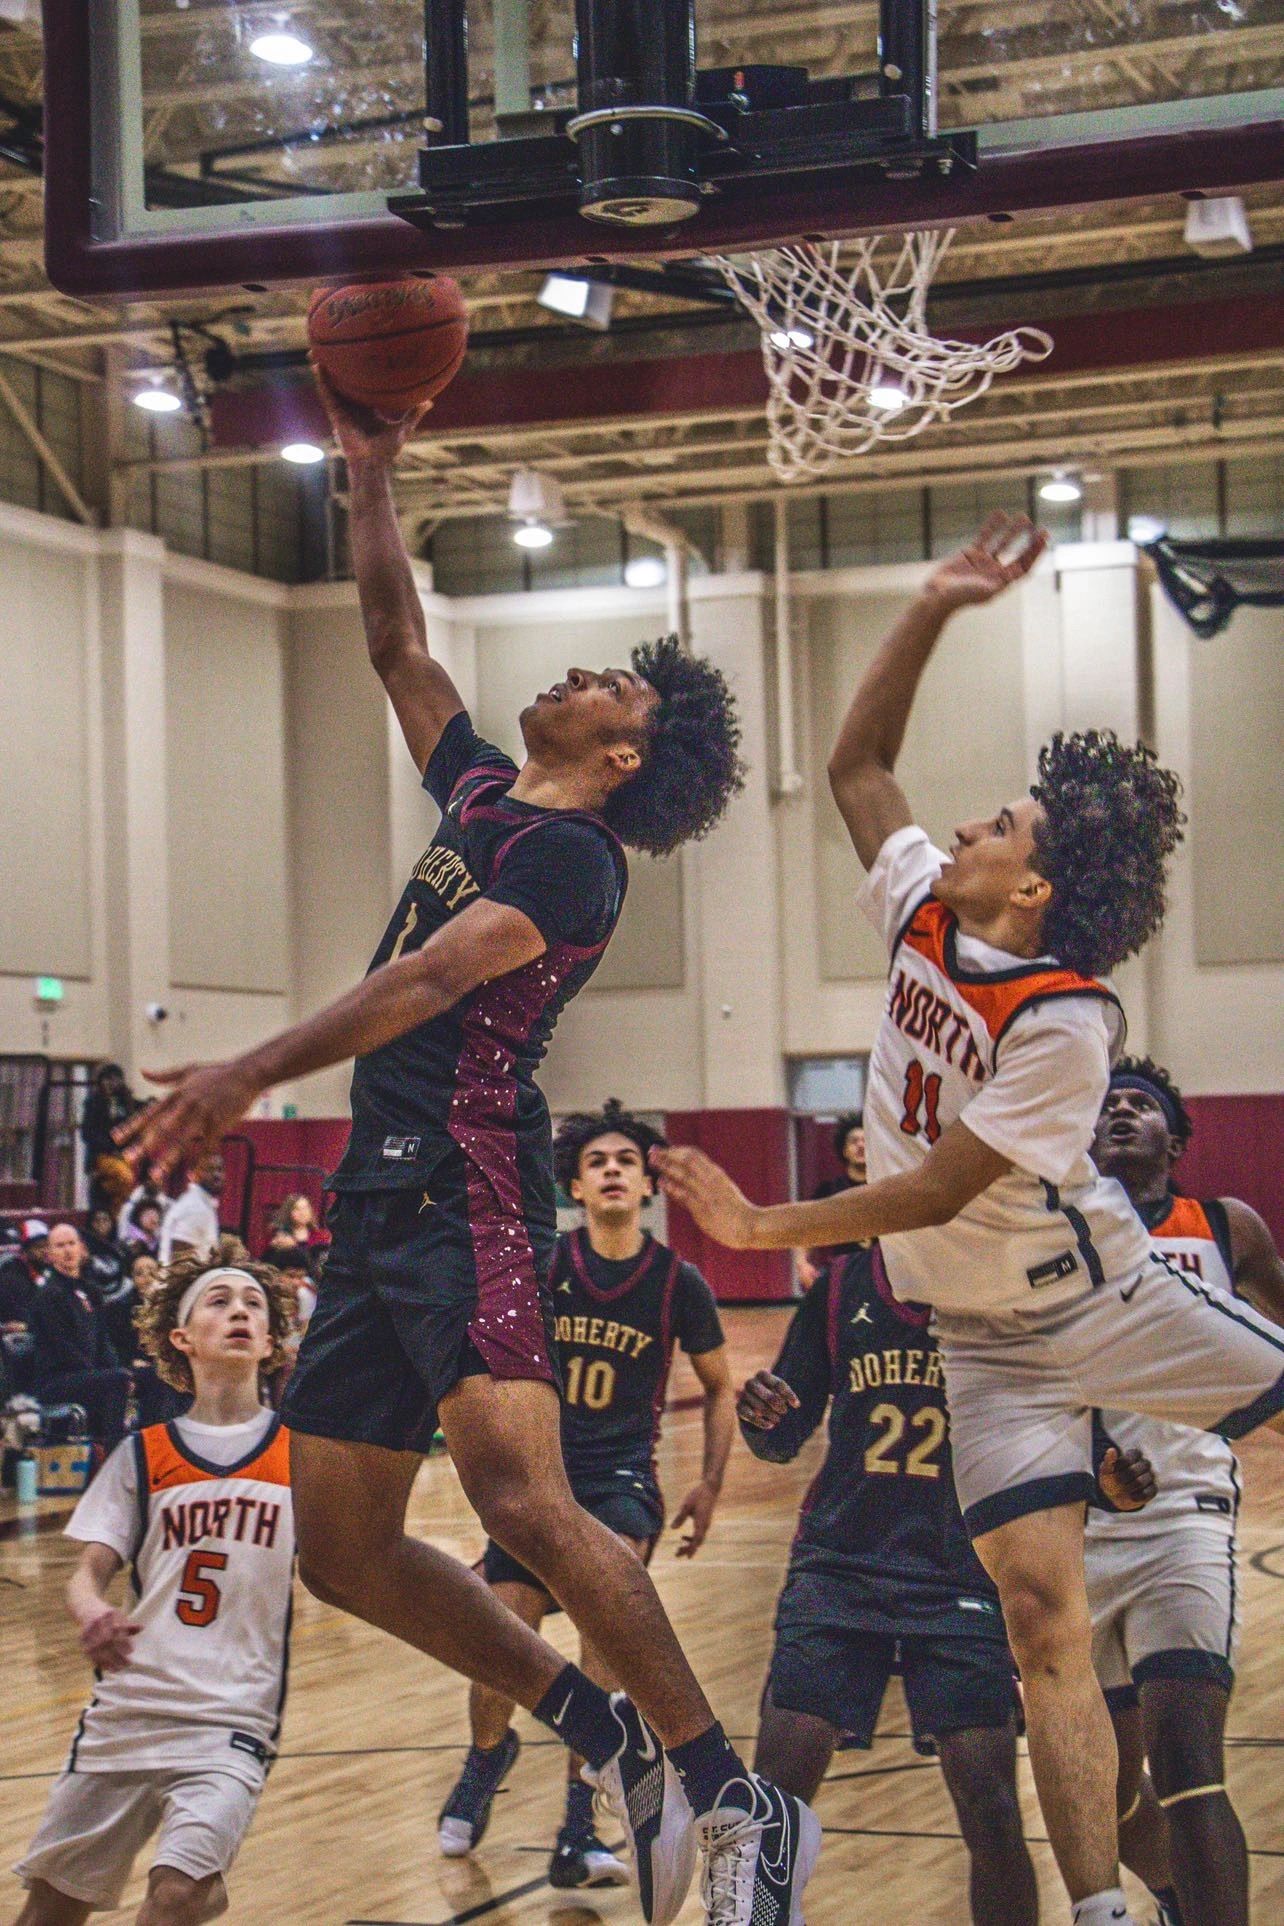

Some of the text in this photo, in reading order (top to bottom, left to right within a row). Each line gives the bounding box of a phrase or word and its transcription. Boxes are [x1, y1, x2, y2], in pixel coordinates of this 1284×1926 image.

[411, 846, 481, 911] OHERTY
[888, 969, 986, 1081] NORTH
[900, 1058, 942, 1146] 11
[566, 1355, 615, 1411] 10
[849, 1348, 945, 1393] DOHER
[863, 1402, 945, 1478] 22
[161, 1496, 281, 1552] NORTH
[174, 1549, 229, 1628] 5
